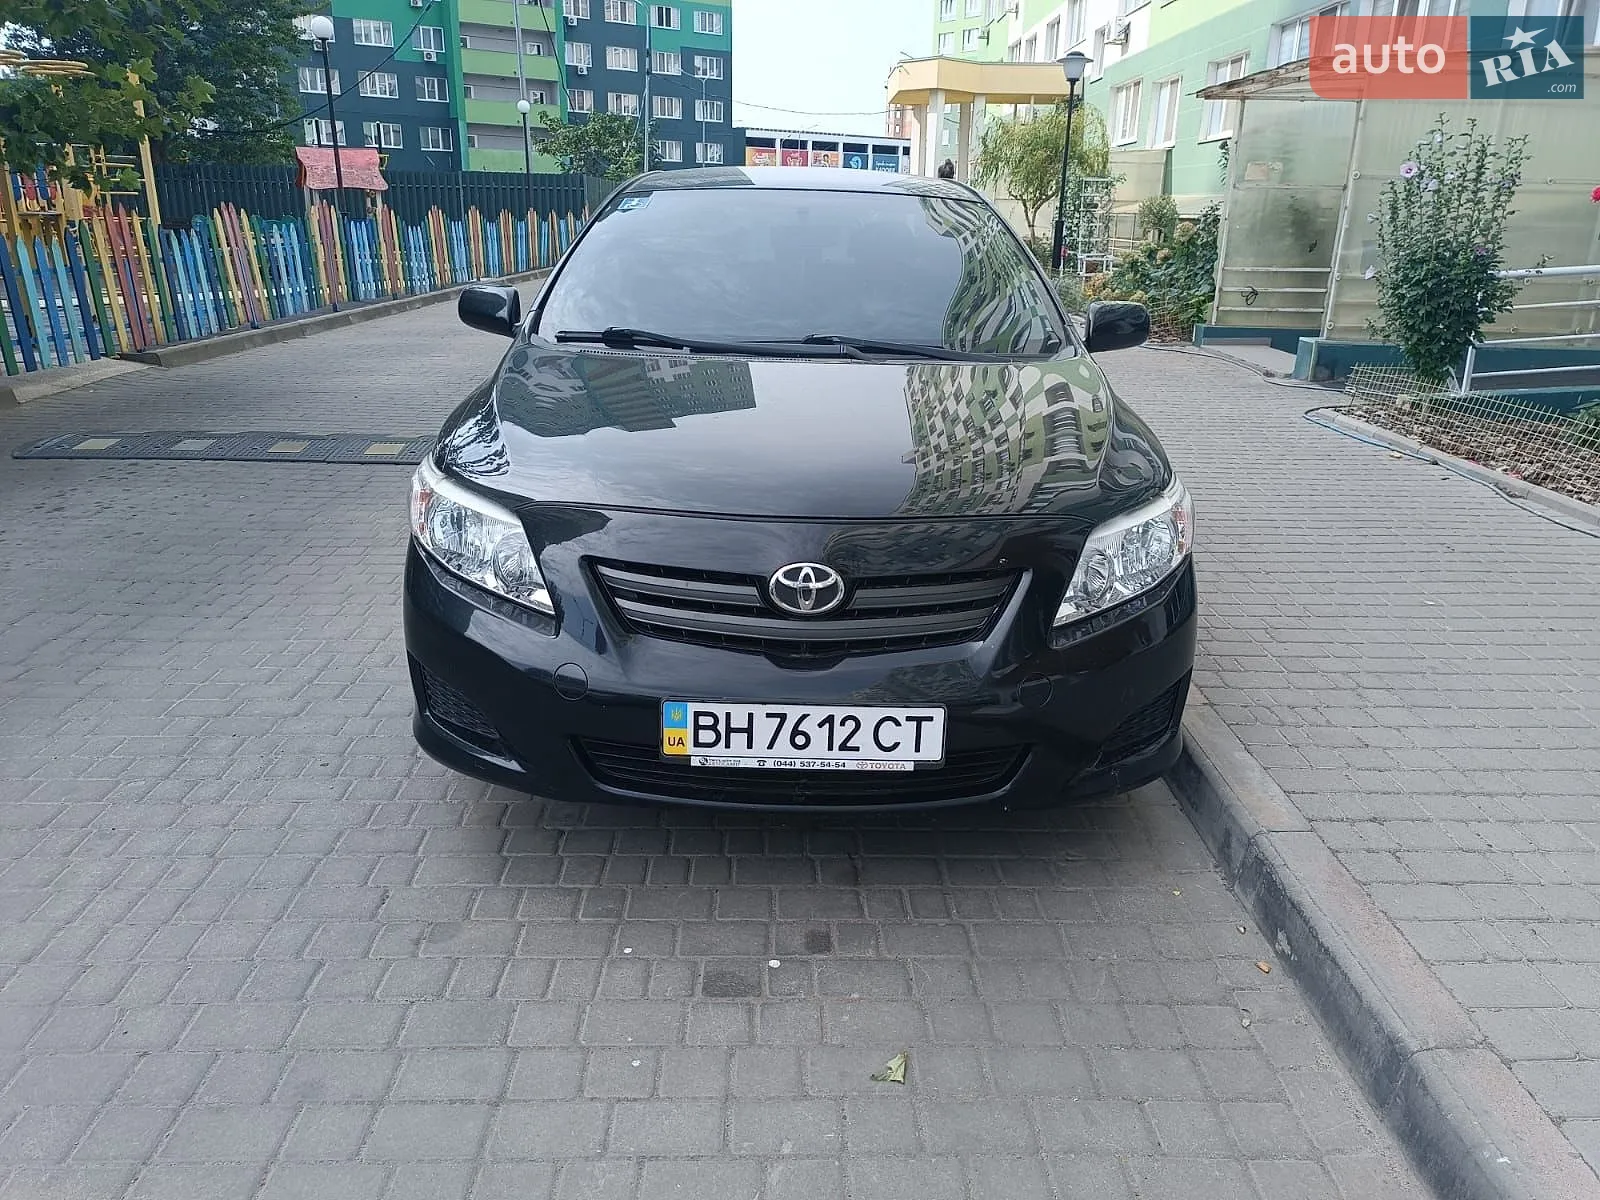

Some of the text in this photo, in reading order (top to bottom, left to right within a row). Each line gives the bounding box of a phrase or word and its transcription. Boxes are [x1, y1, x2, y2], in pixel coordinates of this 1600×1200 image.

[693, 710, 935, 754] BH 7612 CT
[667, 736, 686, 748] UA
[773, 760, 907, 770] (044) 537-54-54 TOYOTA
